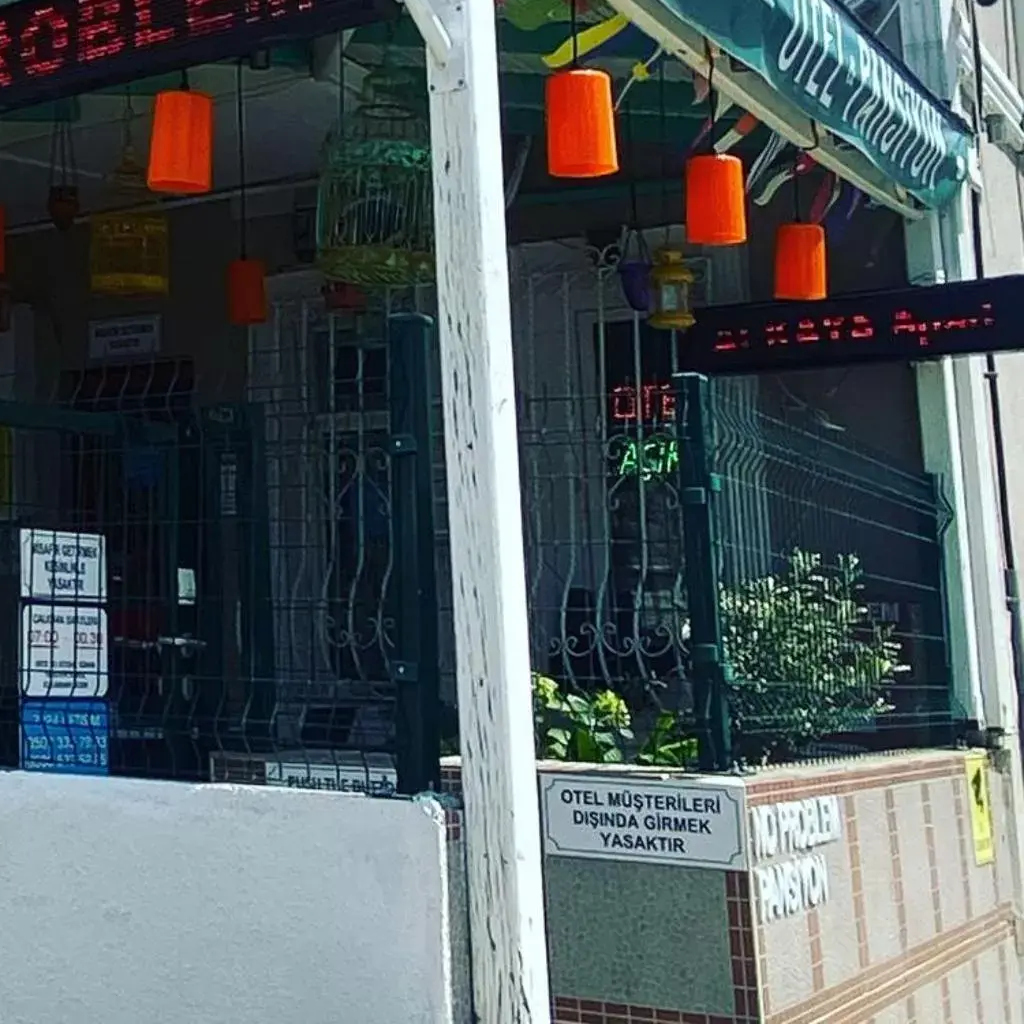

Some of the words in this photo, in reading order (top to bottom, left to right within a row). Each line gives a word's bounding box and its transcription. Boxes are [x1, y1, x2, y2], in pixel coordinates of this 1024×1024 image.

[613, 384, 676, 419] OTE
[561, 788, 604, 806] OTEL
[608, 791, 721, 814] MÜŞTERİLERİ
[573, 810, 639, 829] DIŞINDA
[644, 812, 712, 834] GİRMEK
[600, 832, 686, 853] YASAKTIR
